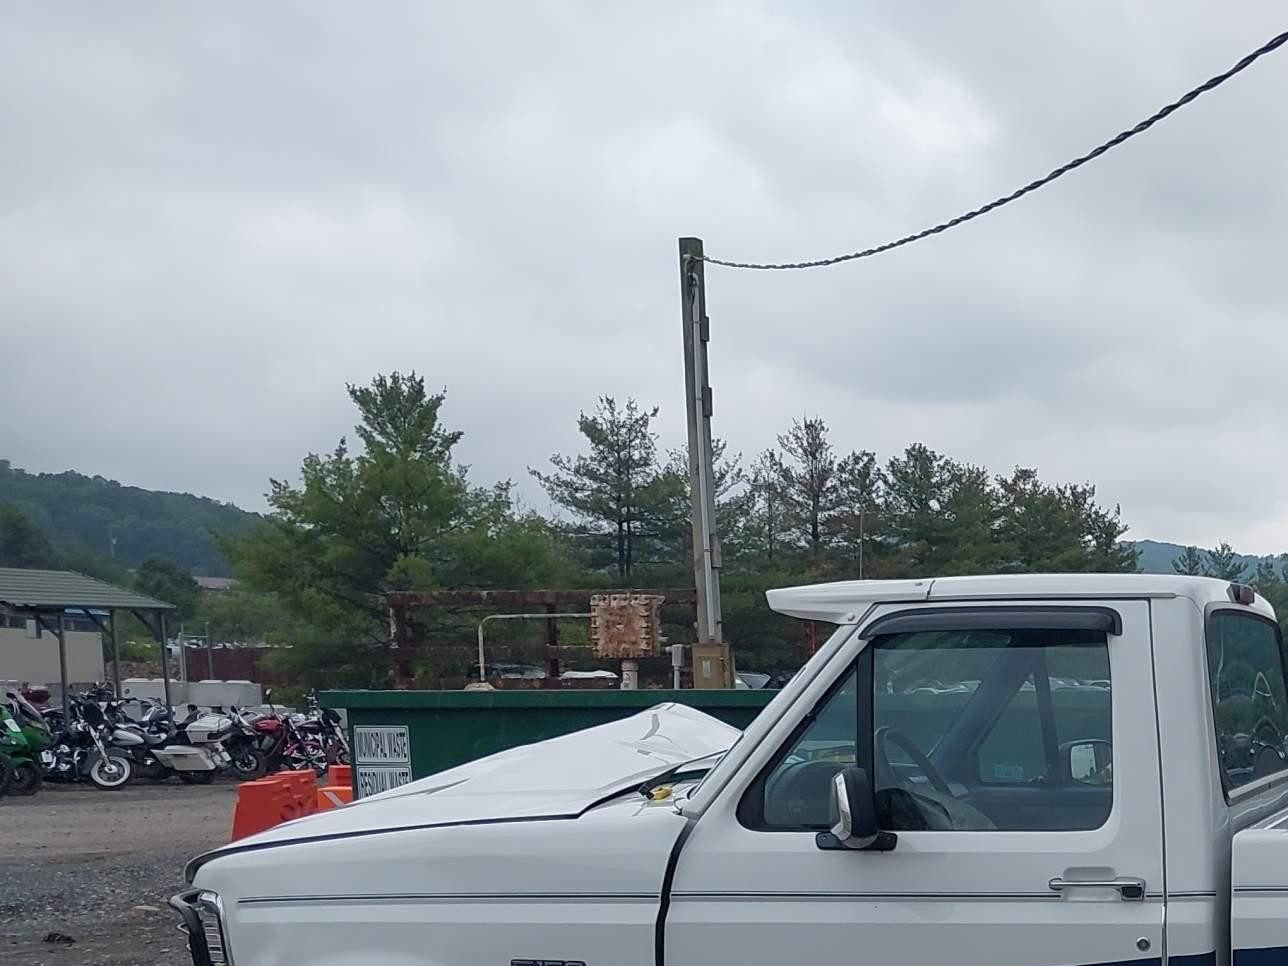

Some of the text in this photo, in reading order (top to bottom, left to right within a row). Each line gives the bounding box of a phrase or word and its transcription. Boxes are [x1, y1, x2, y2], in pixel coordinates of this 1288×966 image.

[357, 731, 407, 759] MUNICIPAL WASTE
[360, 771, 389, 798] RESIDUAL
